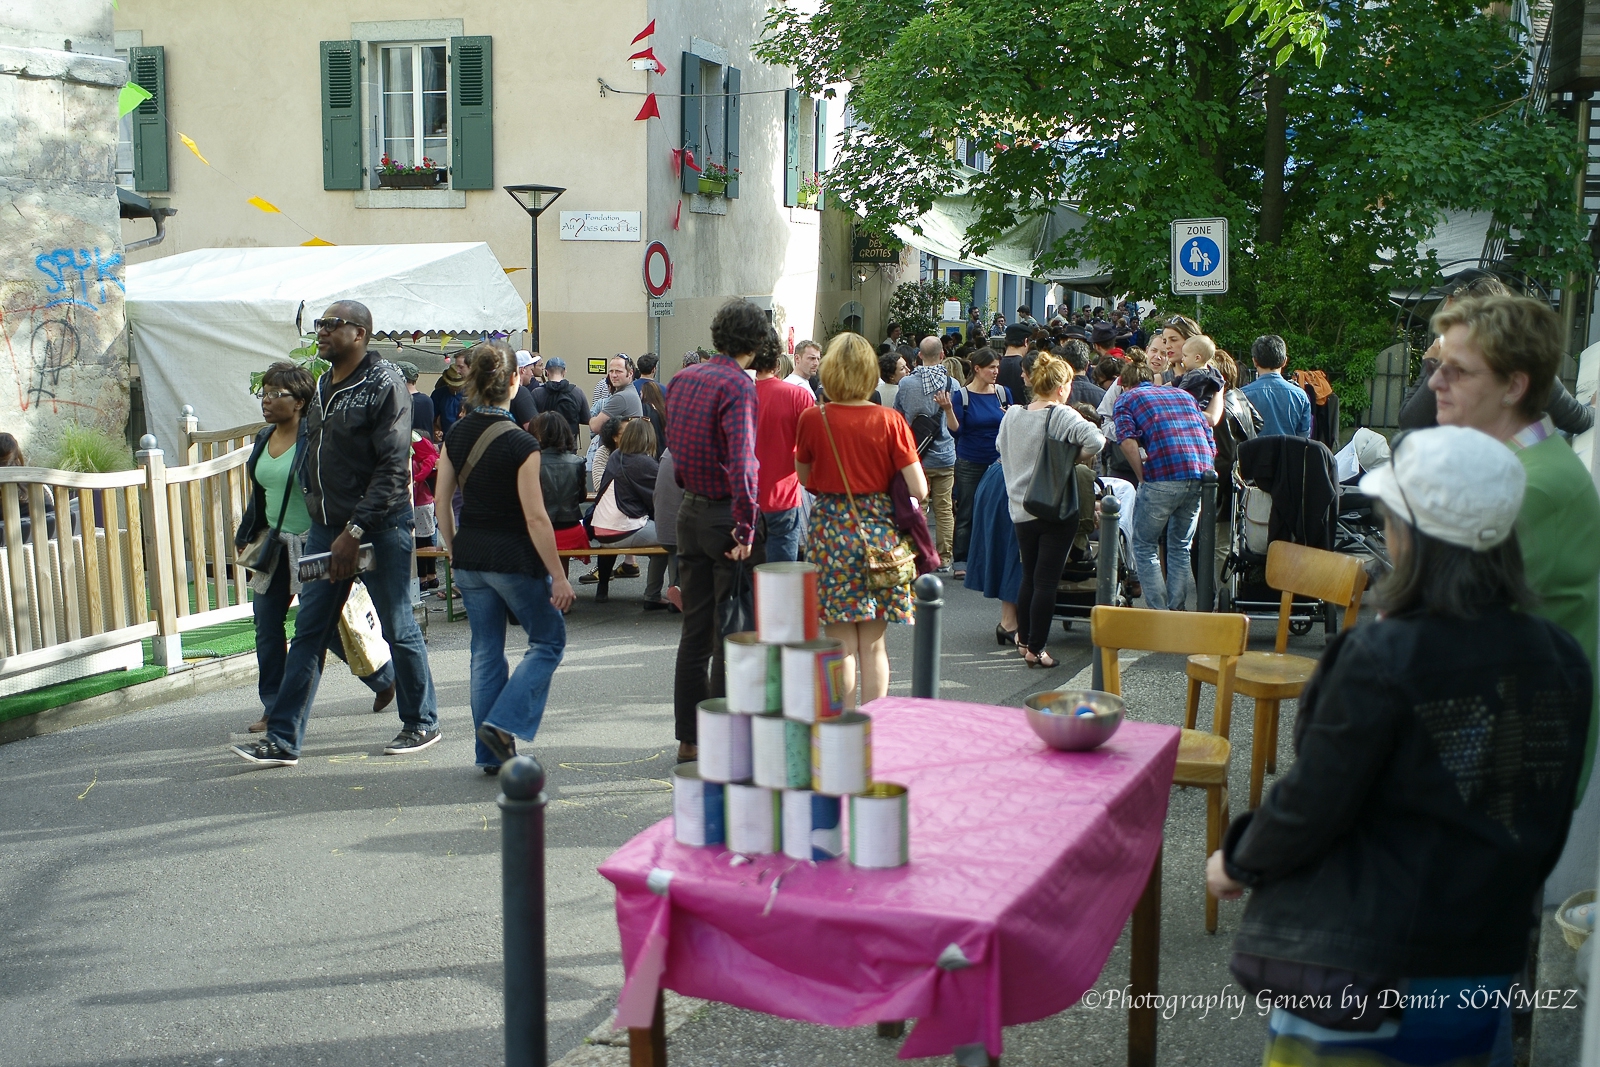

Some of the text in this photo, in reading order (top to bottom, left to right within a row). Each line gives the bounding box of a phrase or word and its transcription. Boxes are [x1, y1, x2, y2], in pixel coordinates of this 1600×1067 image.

[585, 213, 620, 221] Fondation
[1187, 226, 1212, 235] ZONE
[868, 239, 883, 248] DES
[859, 248, 892, 258] GROTTES
[1193, 279, 1221, 288] exceptés
[652, 301, 664, 309] Ayants
